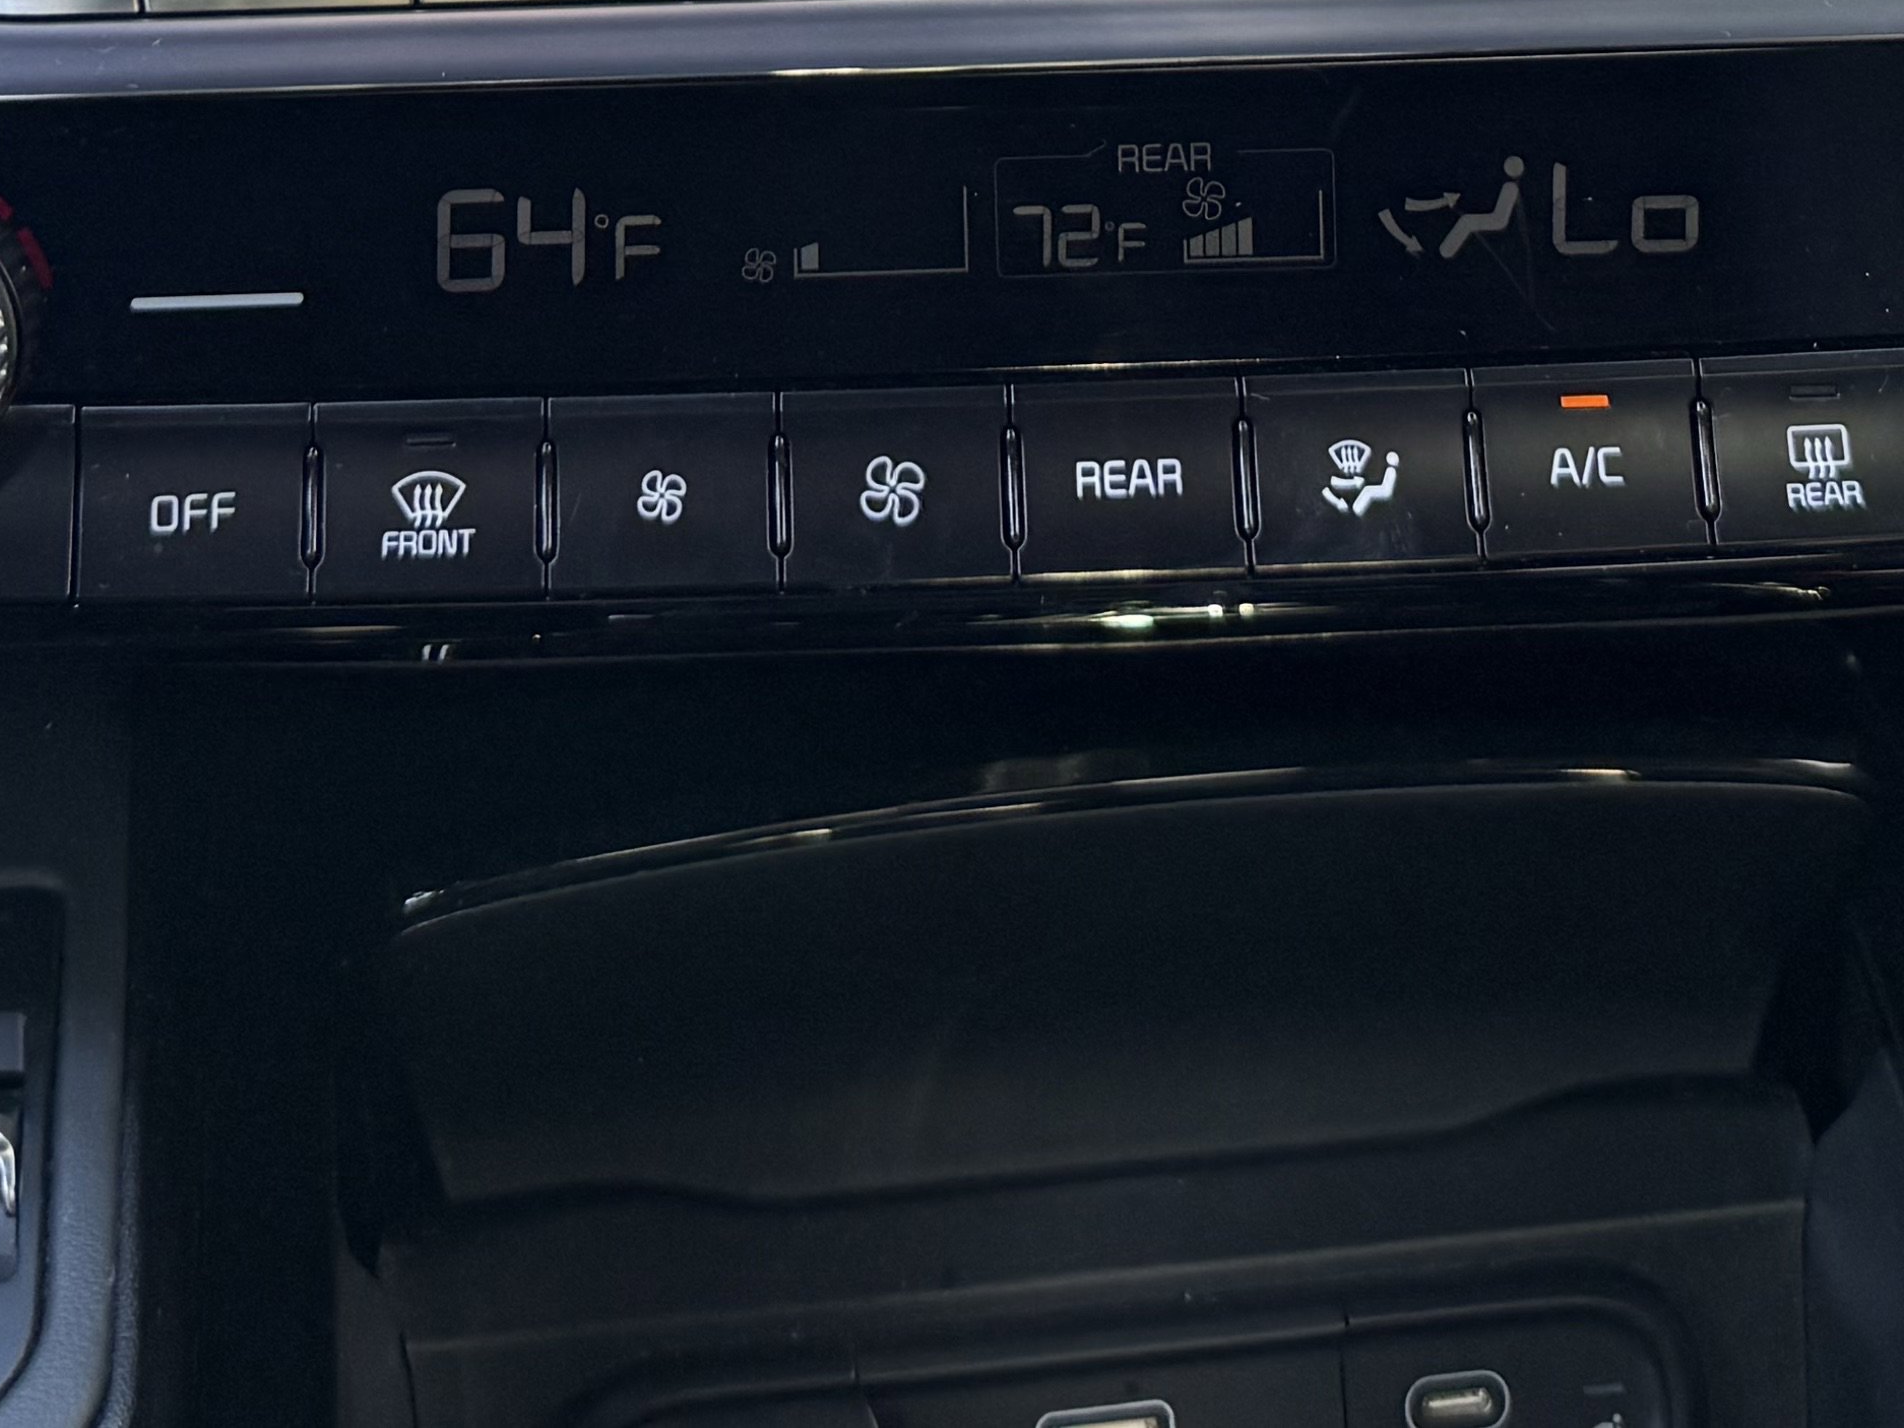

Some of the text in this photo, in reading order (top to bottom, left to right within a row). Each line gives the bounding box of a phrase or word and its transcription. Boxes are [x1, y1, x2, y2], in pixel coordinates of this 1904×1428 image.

[1117, 142, 1212, 173] REAR
[1075, 459, 1183, 499] REAR
[1549, 445, 1626, 489] A/C
[1786, 479, 1866, 509] REAR
[150, 491, 238, 536] OFF
[380, 526, 476, 560] FRONT
